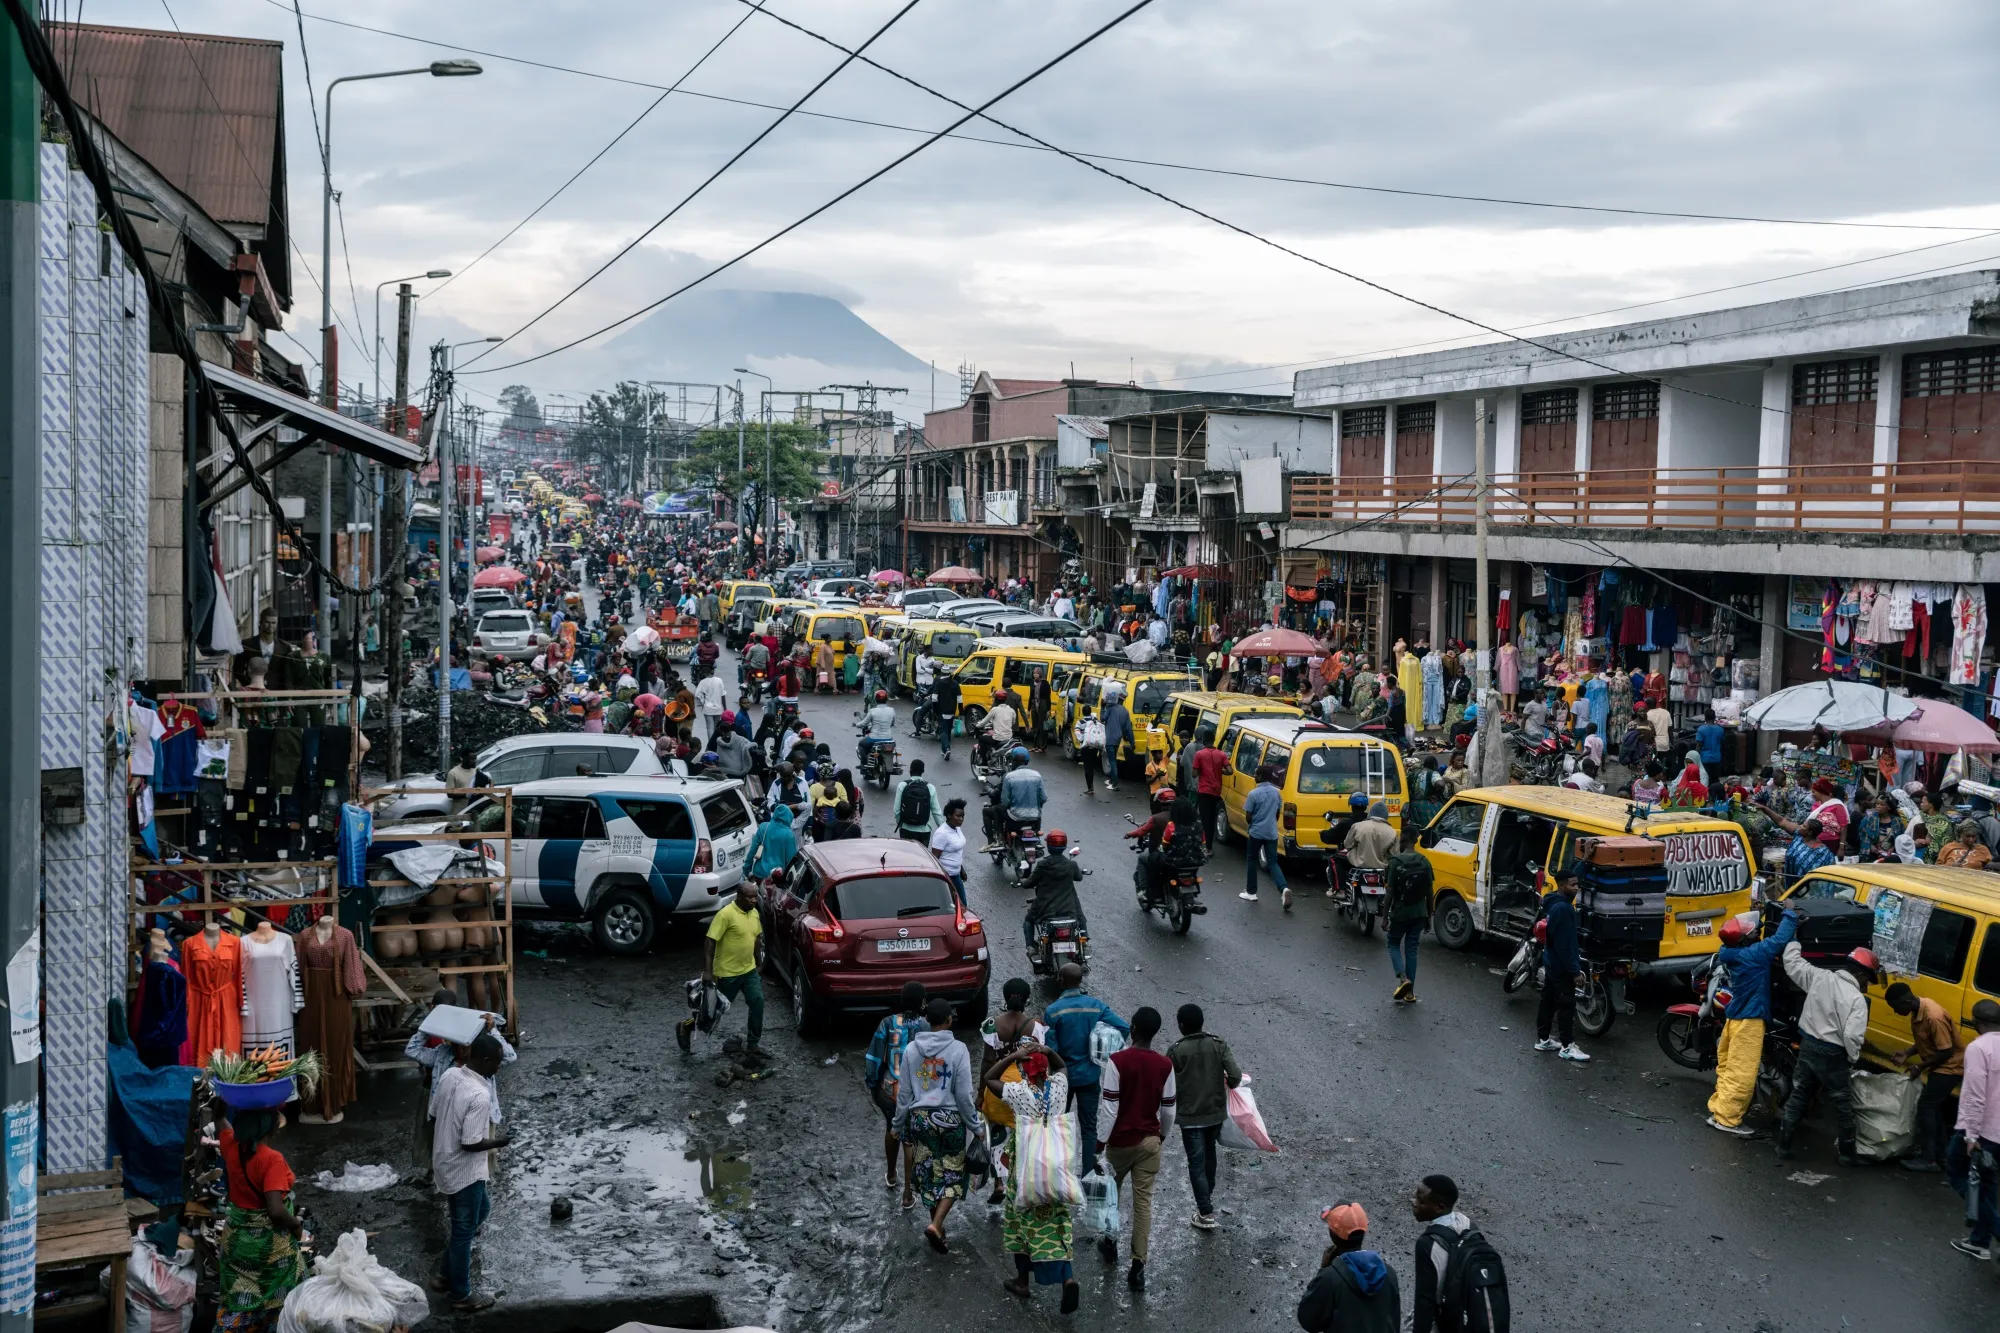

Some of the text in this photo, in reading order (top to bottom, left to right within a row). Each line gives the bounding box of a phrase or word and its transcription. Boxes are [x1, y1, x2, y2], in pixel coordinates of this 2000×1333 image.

[986, 490, 1016, 502] BEST PAINT
[1683, 864, 1742, 894] WAKATI
[919, 939, 930, 949] 19
